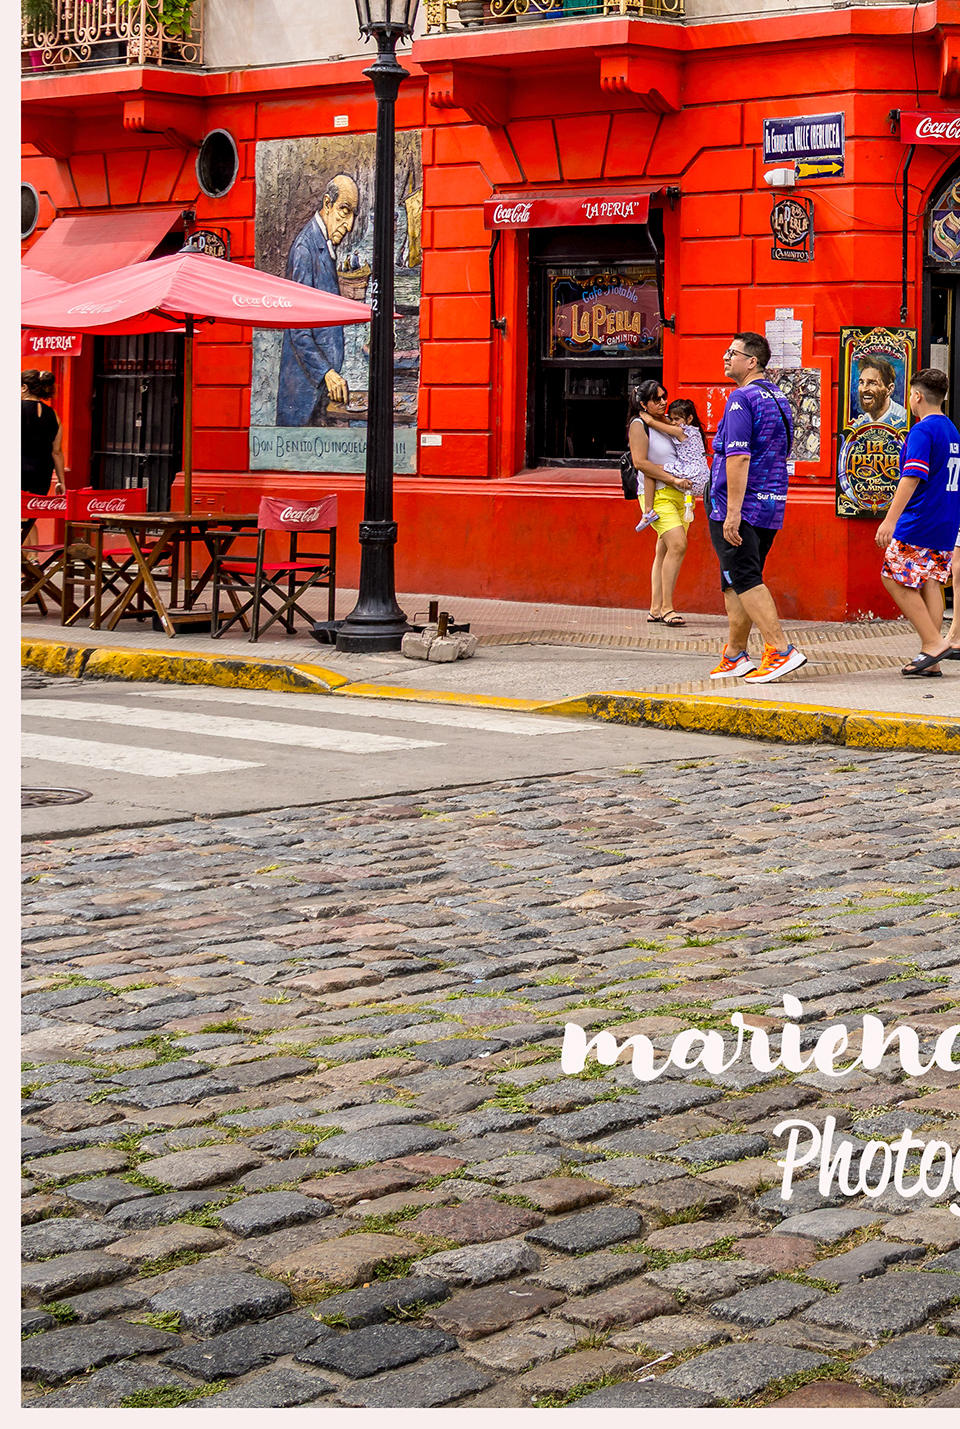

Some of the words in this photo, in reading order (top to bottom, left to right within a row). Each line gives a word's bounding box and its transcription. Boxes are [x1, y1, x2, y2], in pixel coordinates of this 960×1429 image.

[494, 203, 532, 224] Coca-Cola
[232, 293, 293, 308] Coca-Cola
[571, 304, 590, 343] LA
[591, 303, 640, 343] PERLA
[606, 334, 638, 345] CAMINITO
[870, 335, 893, 345] BAR
[253, 436, 273, 457] DON
[276, 436, 312, 457] BENITO
[866, 440, 885, 455] LA
[850, 453, 900, 479] PERLA
[946, 457, 960, 491] 17
[855, 483, 897, 493] CAMINITO
[757, 492, 769, 500] Sur
[87, 498, 127, 512] Coca-Cola
[280, 505, 322, 522] Coca-Cola
